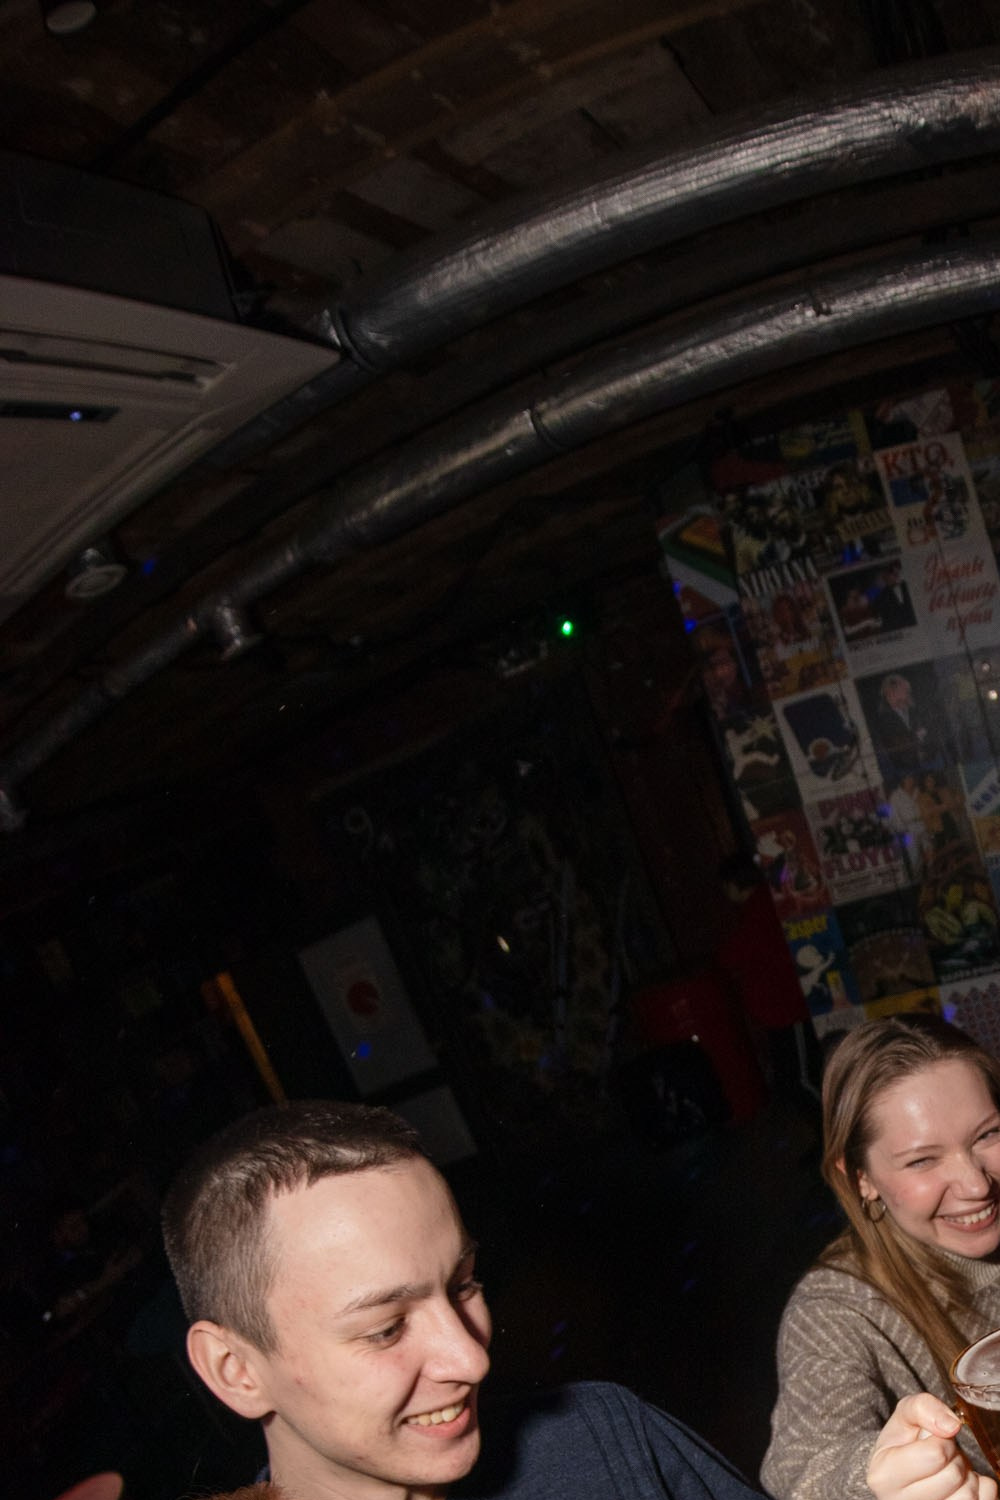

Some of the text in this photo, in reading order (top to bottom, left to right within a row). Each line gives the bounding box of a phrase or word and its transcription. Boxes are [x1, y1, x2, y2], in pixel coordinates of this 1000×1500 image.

[736, 554, 818, 597] NIRVANA
[817, 786, 880, 820] PINK
[824, 843, 901, 880] FLOYD
